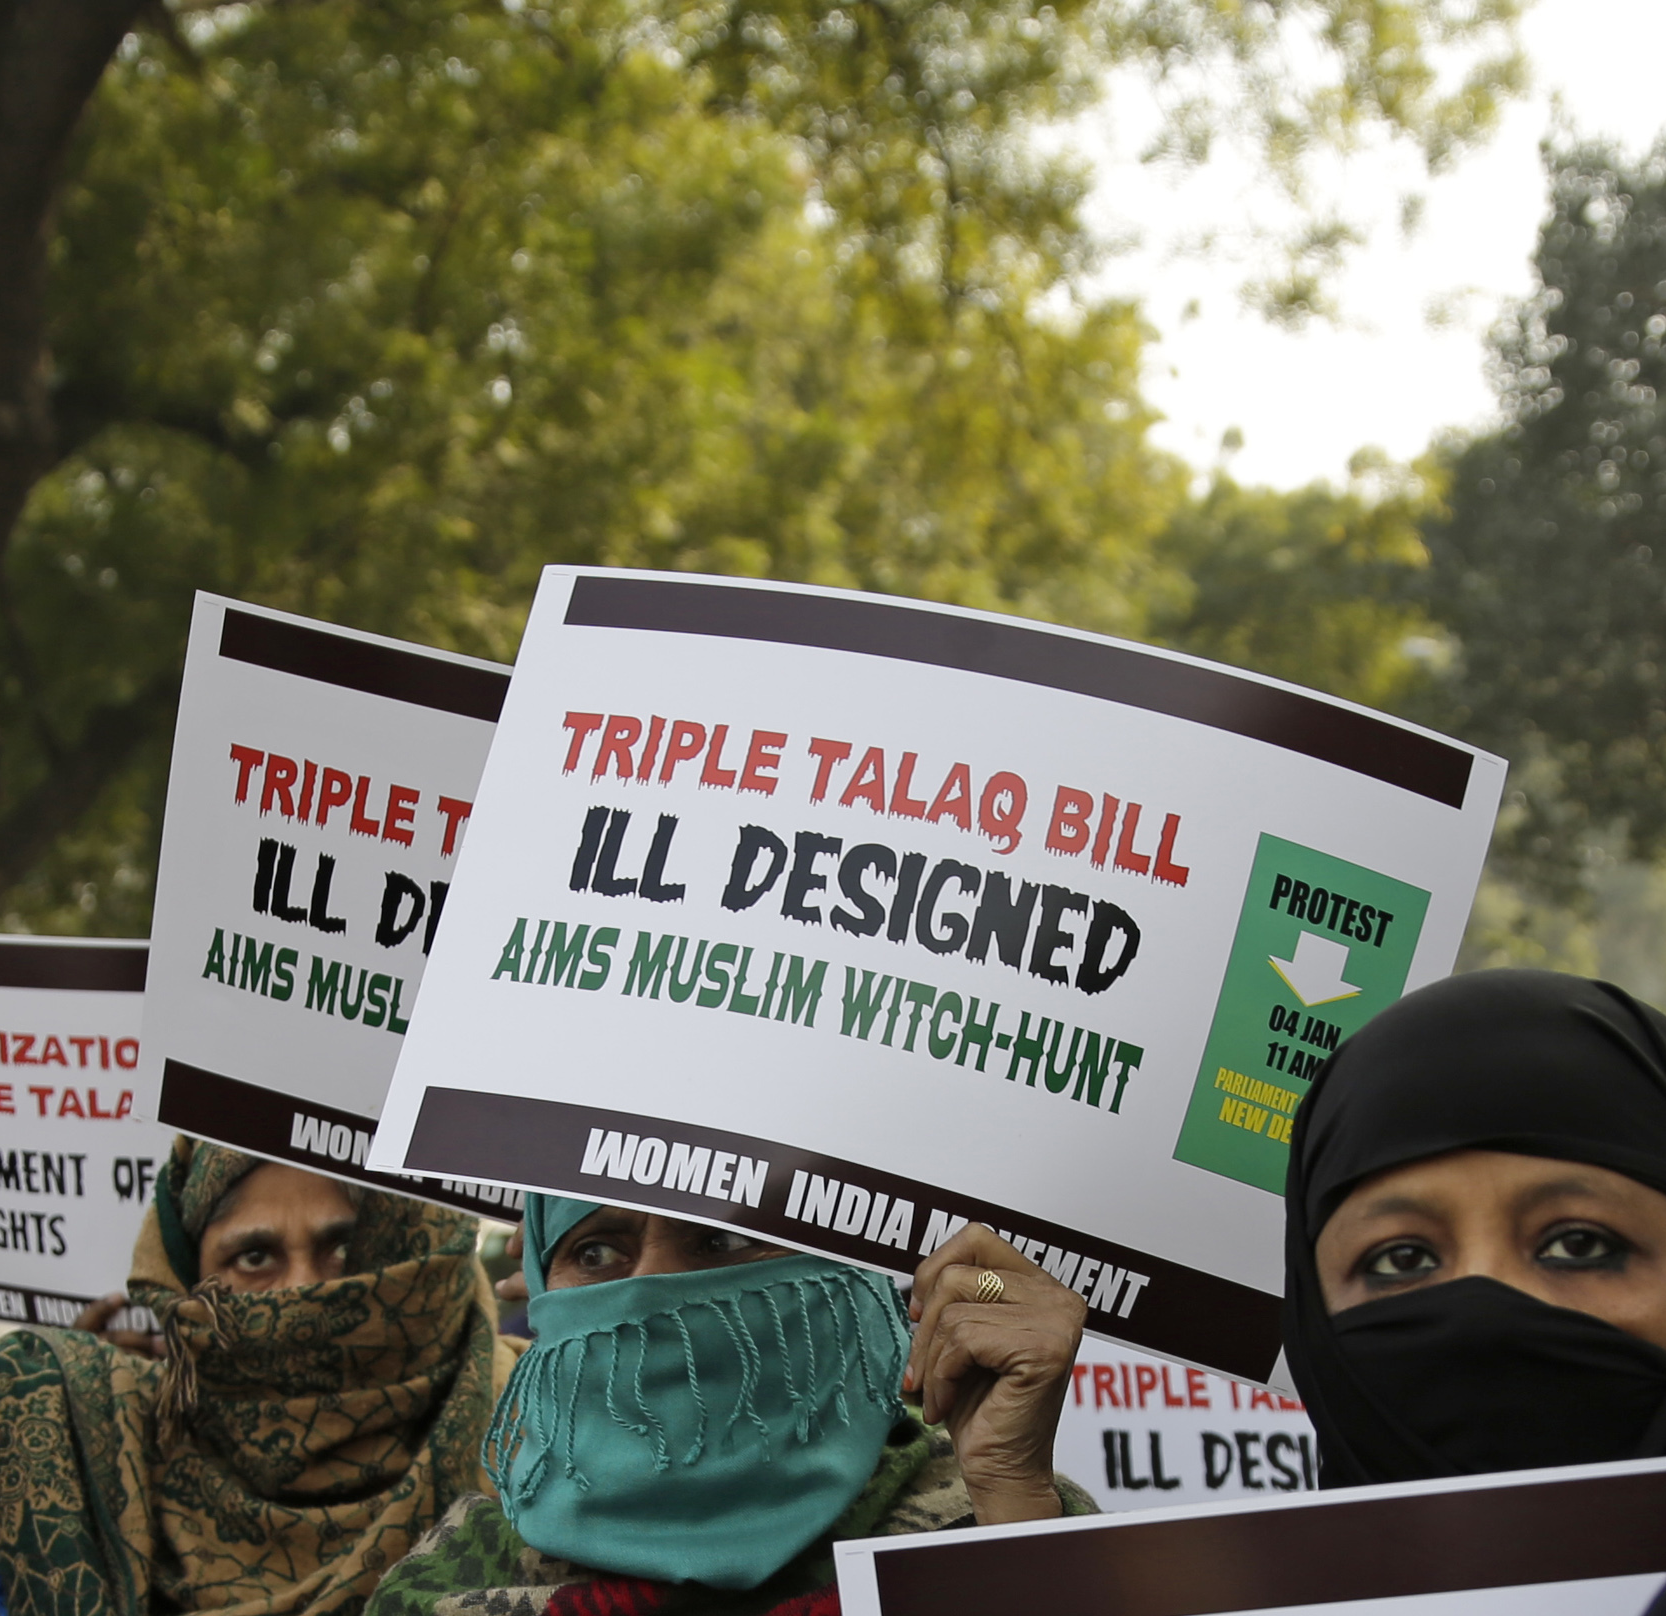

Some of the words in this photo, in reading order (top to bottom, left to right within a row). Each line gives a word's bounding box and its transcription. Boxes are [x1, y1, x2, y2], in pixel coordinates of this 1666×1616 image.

[230, 743, 420, 849] TRIPLE
[563, 711, 788, 796] TRIPLE
[806, 737, 1028, 855] TALAQ
[1043, 784, 1191, 887] BILL
[252, 836, 347, 937] ILL
[569, 805, 687, 904] ILL
[723, 822, 1141, 996] DESIGNED
[1268, 873, 1394, 948] PROTEST
[201, 927, 299, 1002] AIMS
[305, 954, 410, 1035] MUSL
[490, 916, 620, 992] AIMS
[622, 934, 832, 1030] MUSLIM
[839, 969, 1144, 1117] WITCH-HUNT
[1268, 1004, 1301, 1037] 04
[1299, 1013, 1342, 1052] JAN
[1266, 1041, 1289, 1070] 11
[29, 1085, 133, 1120] TALA
[1214, 1067, 1299, 1114] PARLIAMENT
[1219, 1096, 1268, 1134] NEW
[113, 1158, 154, 1204] OF
[580, 1128, 769, 1208] WOMEN
[784, 1169, 915, 1251] INDIA
[1071, 1362, 1211, 1412] TRIPLE
[1102, 1429, 1180, 1490] ILL
[1200, 1431, 1315, 1491] DESI
